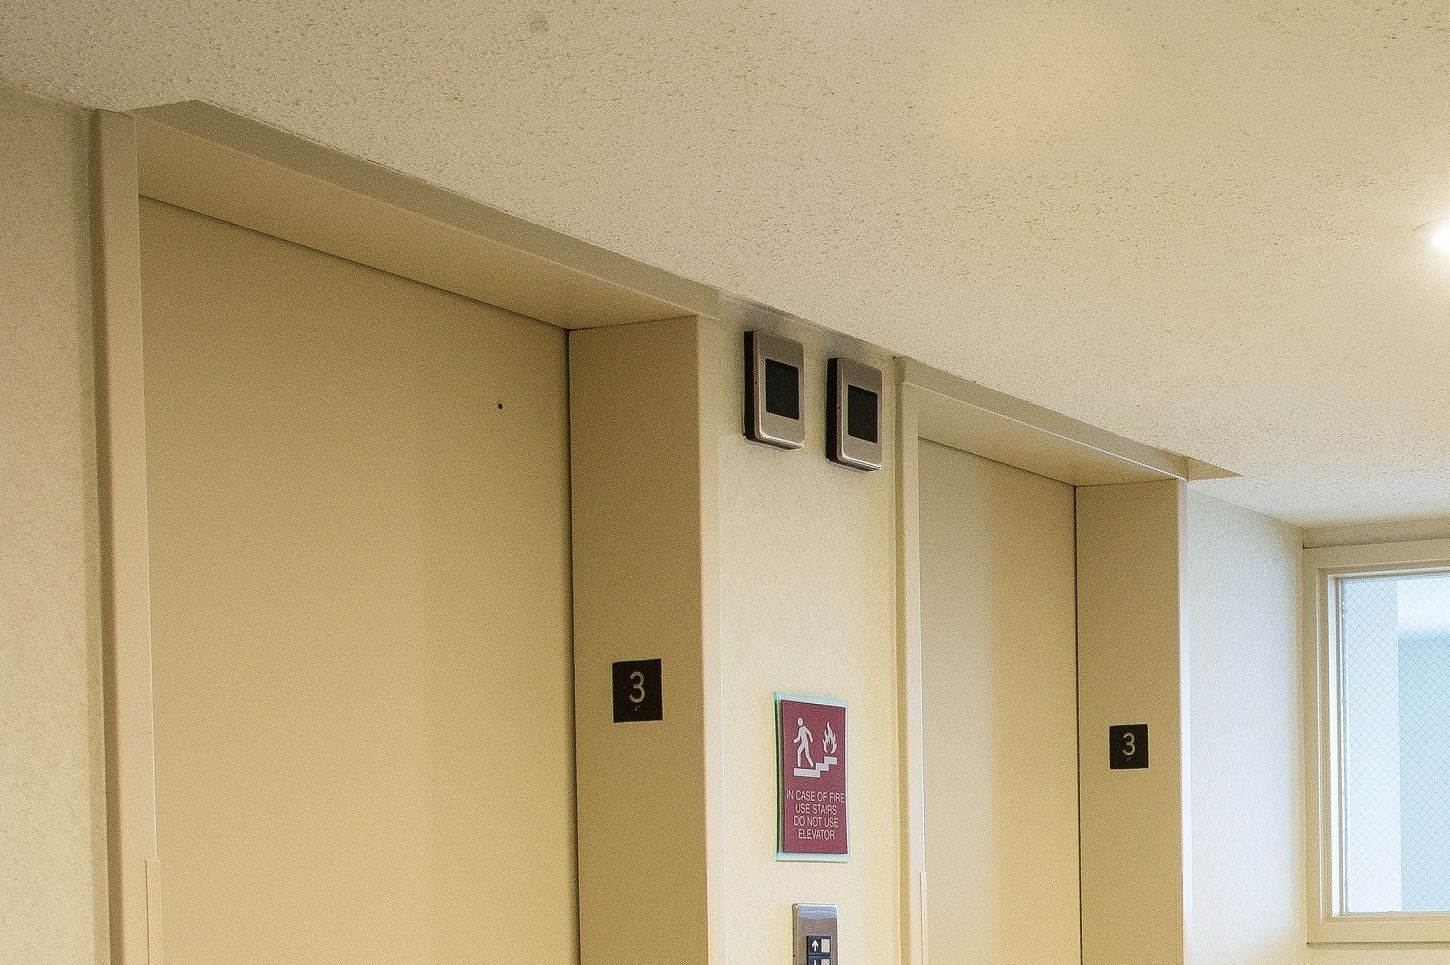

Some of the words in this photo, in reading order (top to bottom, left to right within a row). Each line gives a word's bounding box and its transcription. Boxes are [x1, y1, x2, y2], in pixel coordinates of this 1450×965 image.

[629, 671, 645, 703] 3
[1122, 732, 1136, 756] 3
[786, 789, 794, 800] IN
[795, 789, 816, 801] CASE
[816, 791, 828, 802] OF
[829, 792, 845, 803] FIRE
[795, 802, 810, 814] USE
[812, 803, 837, 816] STAIRS
[793, 815, 805, 826] DO
[807, 816, 822, 827] NOT
[824, 817, 839, 828] USE
[798, 828, 835, 840] ELEVATOR
